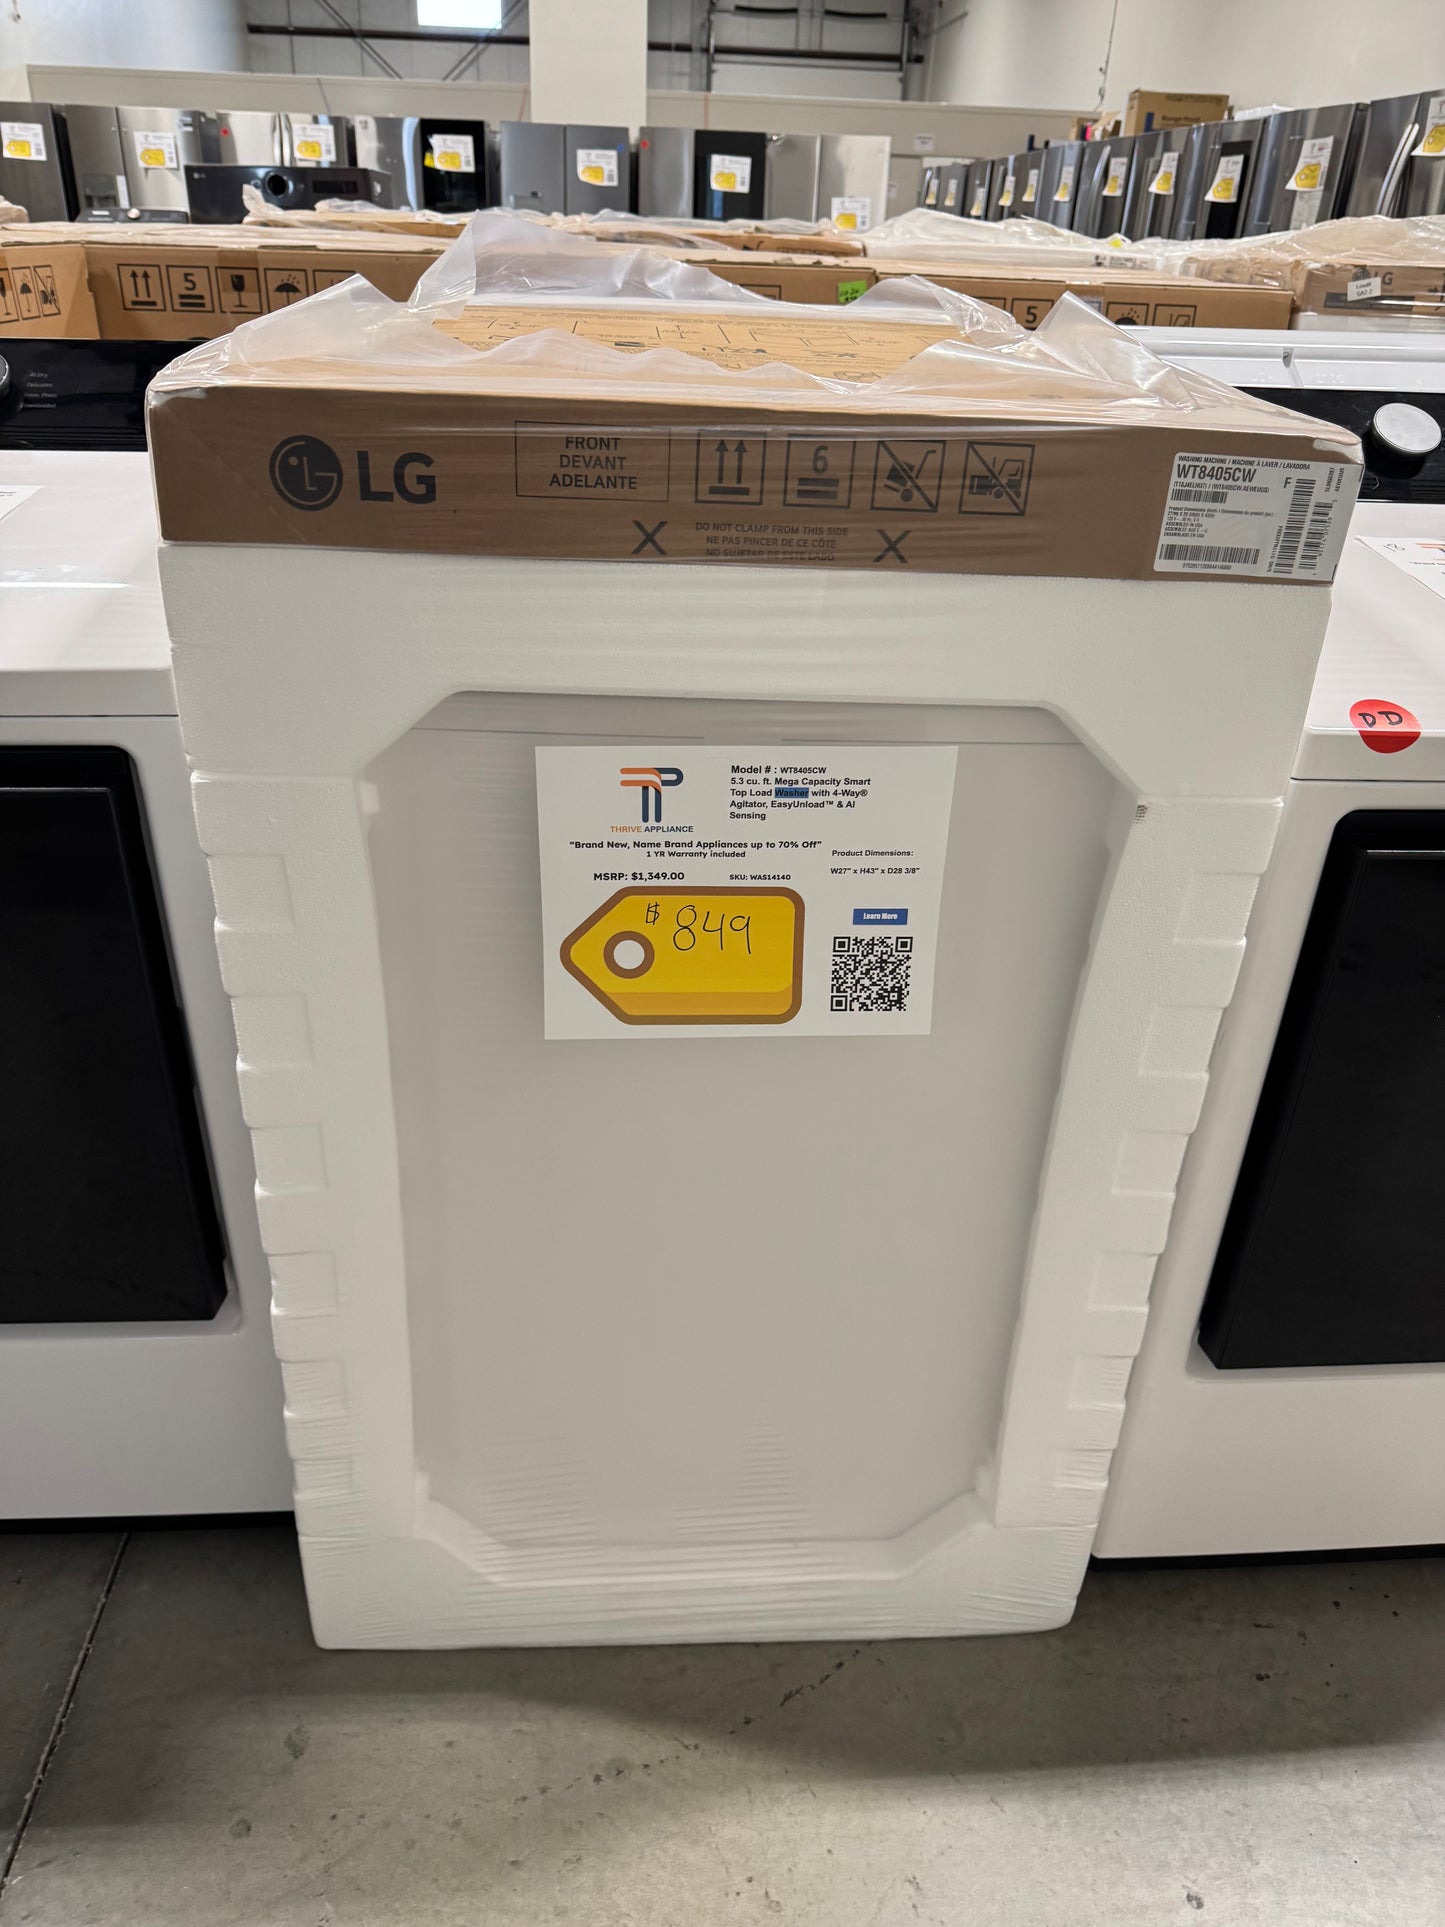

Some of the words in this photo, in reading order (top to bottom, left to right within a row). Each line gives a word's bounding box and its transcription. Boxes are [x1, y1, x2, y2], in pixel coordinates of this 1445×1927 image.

[182, 272, 197, 291] 5
[1025, 305, 1038, 324] 5
[565, 436, 621, 451] FRONT
[559, 454, 627, 471] DEVANT
[812, 444, 829, 474] 6
[1178, 455, 1202, 463] WASHING
[1203, 456, 1227, 465] MACHINE
[1232, 459, 1255, 467] MACHINE
[1261, 460, 1279, 469] LAVER
[1282, 462, 1311, 470] LAVADORA
[357, 450, 437, 505] LG
[1176, 463, 1258, 483] WT8405CW
[549, 473, 638, 490] ADELANTE
[1283, 477, 1293, 489] F
[695, 521, 710, 531] DO
[712, 522, 732, 532] NOT
[735, 524, 770, 534] CLAMP
[771, 525, 800, 534] FROM
[802, 526, 824, 535] THIS
[827, 527, 849, 536] SIDE
[706, 535, 719, 544] NE
[722, 536, 741, 545] PAS
[743, 537, 778, 547] PINCER
[781, 538, 794, 547] DE
[796, 539, 809, 548] CE
[706, 548, 721, 557] NO
[731, 765, 762, 774] Model
[764, 765, 771, 774] #
[780, 766, 827, 774] WT8405CW
[730, 777, 744, 785] 5.3
[763, 777, 772, 785] ft.
[774, 777, 799, 787] Mega
[801, 777, 841, 787] Capacity
[843, 777, 871, 786] Smart
[730, 788, 747, 798] Top
[749, 788, 773, 797] Load
[775, 788, 809, 797] Washer
[811, 788, 831, 797] with
[832, 788, 868, 798] 4-Way®
[729, 800, 768, 809] Agitator,
[770, 800, 834, 809] EasyUnload™
[836, 800, 844, 808] &
[845, 800, 856, 808] AI
[729, 811, 767, 821] Sensing
[609, 825, 643, 833] THRIVE
[643, 825, 694, 833] APPLIANCE
[606, 840, 631, 850] New,
[633, 840, 662, 848] Name
[664, 840, 694, 848] Brand
[695, 840, 748, 850] Appliances
[750, 842, 763, 850] up
[766, 841, 776, 849] to
[778, 840, 799, 849] 70%
[653, 850, 666, 858] YR
[667, 850, 708, 859] Warranty
[710, 850, 746, 858] included
[831, 849, 863, 857] Product
[864, 849, 914, 857] Dimensions:
[593, 872, 628, 881] MSRP:
[630, 871, 685, 882] $1,349.00
[749, 873, 791, 881] WAS14140
[863, 912, 881, 920] Learn
[881, 912, 898, 920] More
[672, 904, 752, 954] 849
